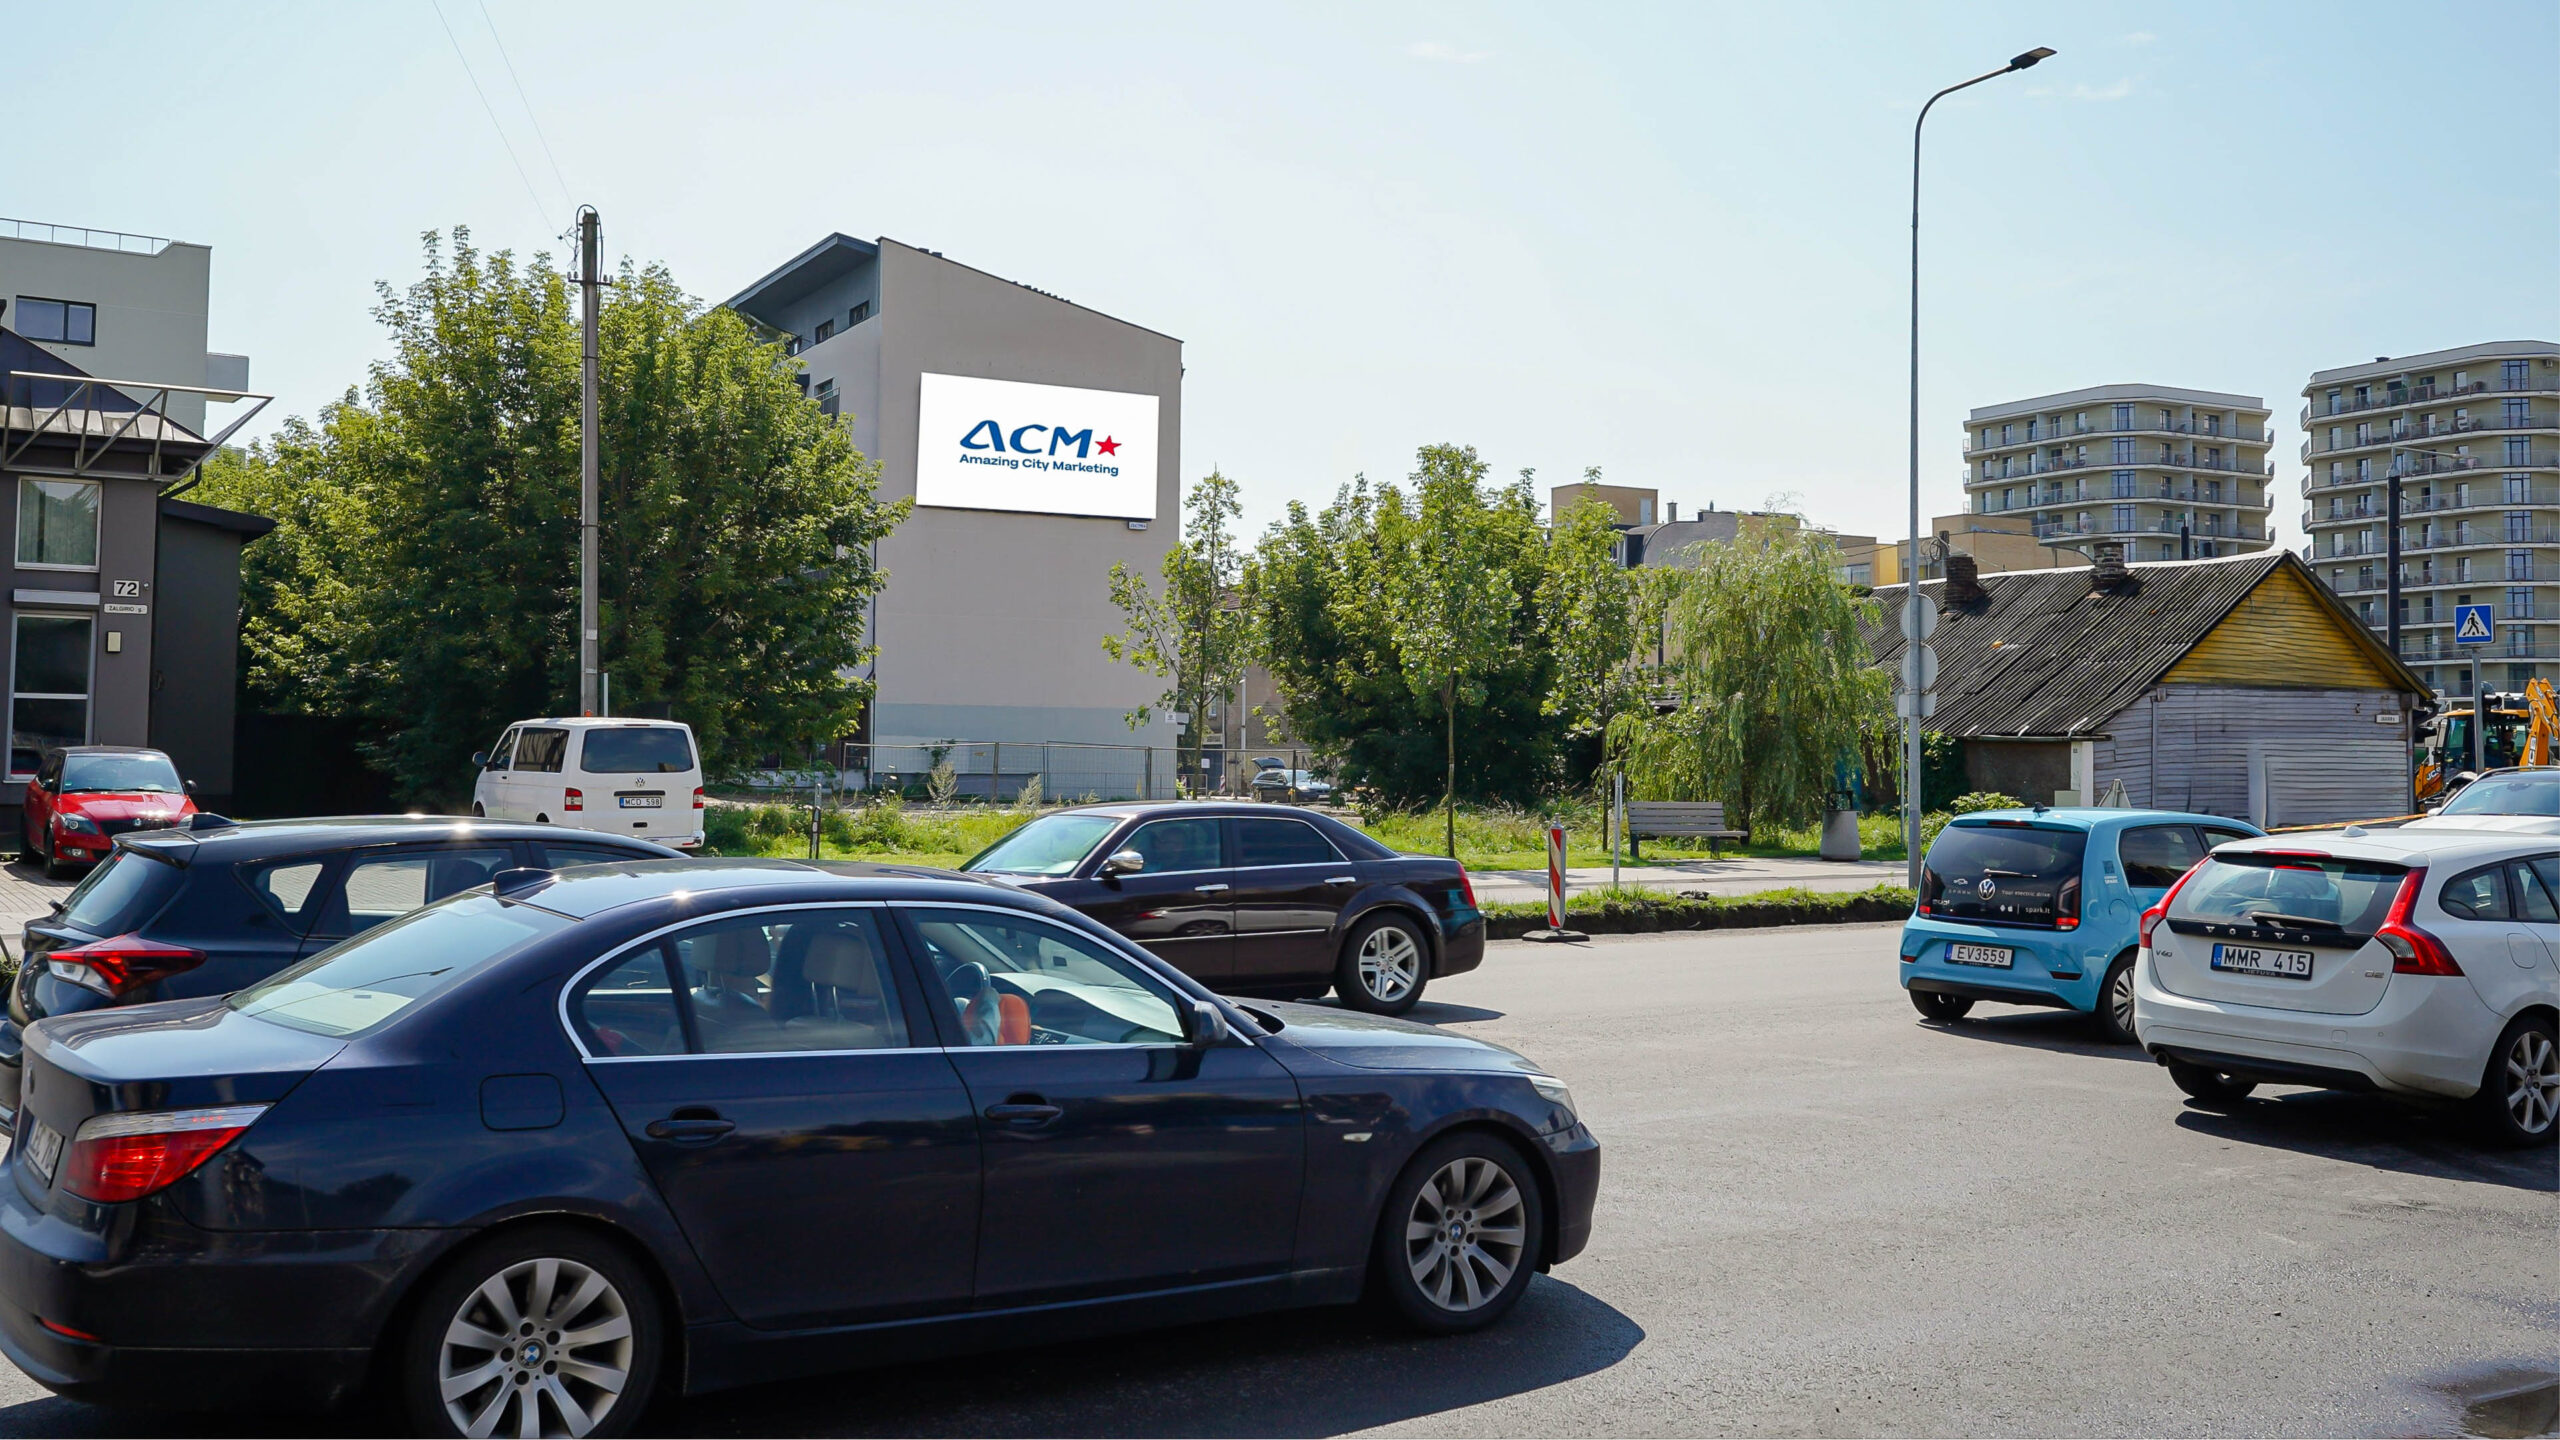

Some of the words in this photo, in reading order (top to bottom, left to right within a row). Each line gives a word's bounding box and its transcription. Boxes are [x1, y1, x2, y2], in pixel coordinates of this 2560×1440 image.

[960, 419, 1093, 459] ACM
[959, 454, 1019, 470] Amazing
[1022, 458, 1050, 472] City
[1053, 461, 1119, 477] Marketing
[116, 582, 137, 595] 72
[646, 798, 660, 806] 598
[2205, 926, 2311, 942] VOLVO
[1957, 946, 2006, 963] EV3559
[2224, 947, 2261, 968] MMR
[2273, 953, 2307, 973] 415
[2243, 968, 2276, 977] LIETUVA
